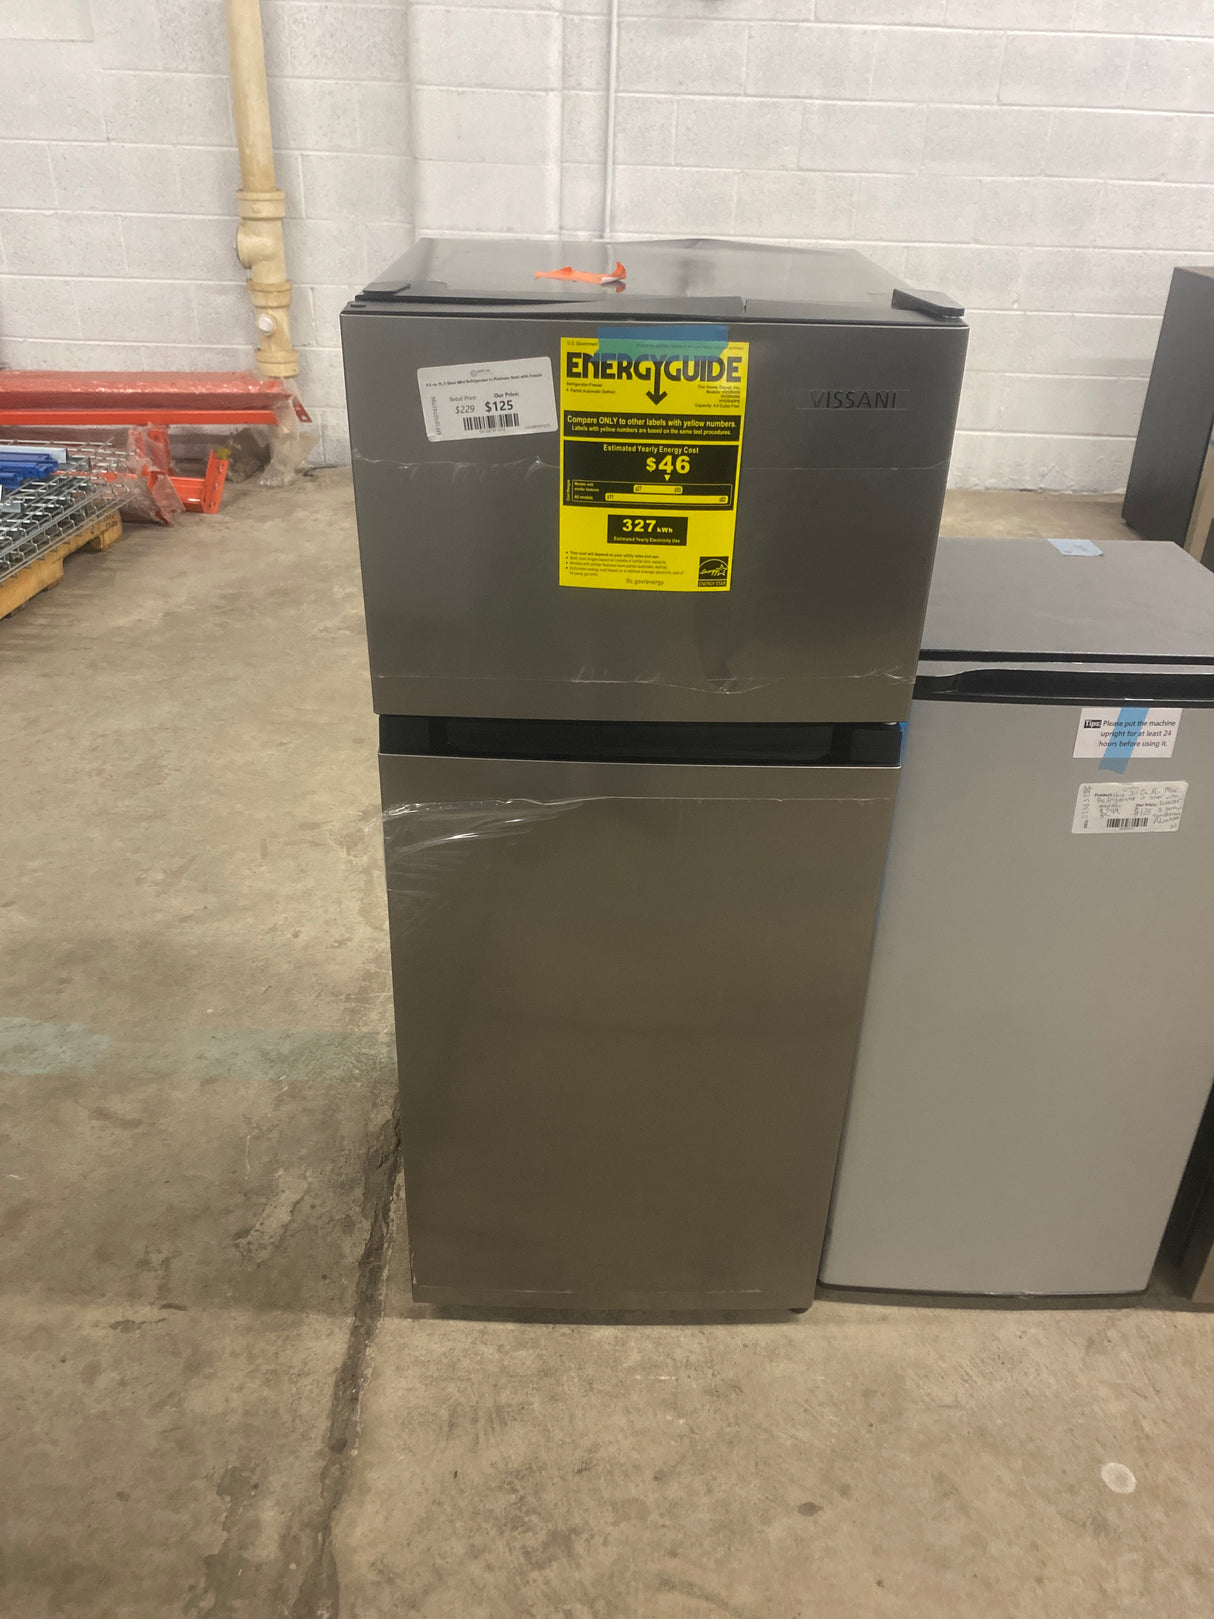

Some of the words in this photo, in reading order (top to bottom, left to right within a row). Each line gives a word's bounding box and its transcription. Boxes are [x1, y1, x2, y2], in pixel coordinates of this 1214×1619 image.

[810, 391, 896, 408] VISSANI
[455, 405, 475, 414] $229
[485, 400, 513, 413] $125
[567, 415, 597, 425] Compare
[599, 417, 618, 425] ONLY
[646, 418, 666, 426] labels
[668, 418, 681, 426] with
[683, 419, 705, 428] yellow
[603, 444, 636, 452] Estimated
[637, 446, 658, 454] Yearly
[659, 446, 682, 454] Energy
[683, 446, 699, 454] Cost
[646, 455, 690, 474] $46
[622, 519, 656, 532] 327
[1124, 720, 1136, 728] put
[1100, 730, 1125, 738] upright
